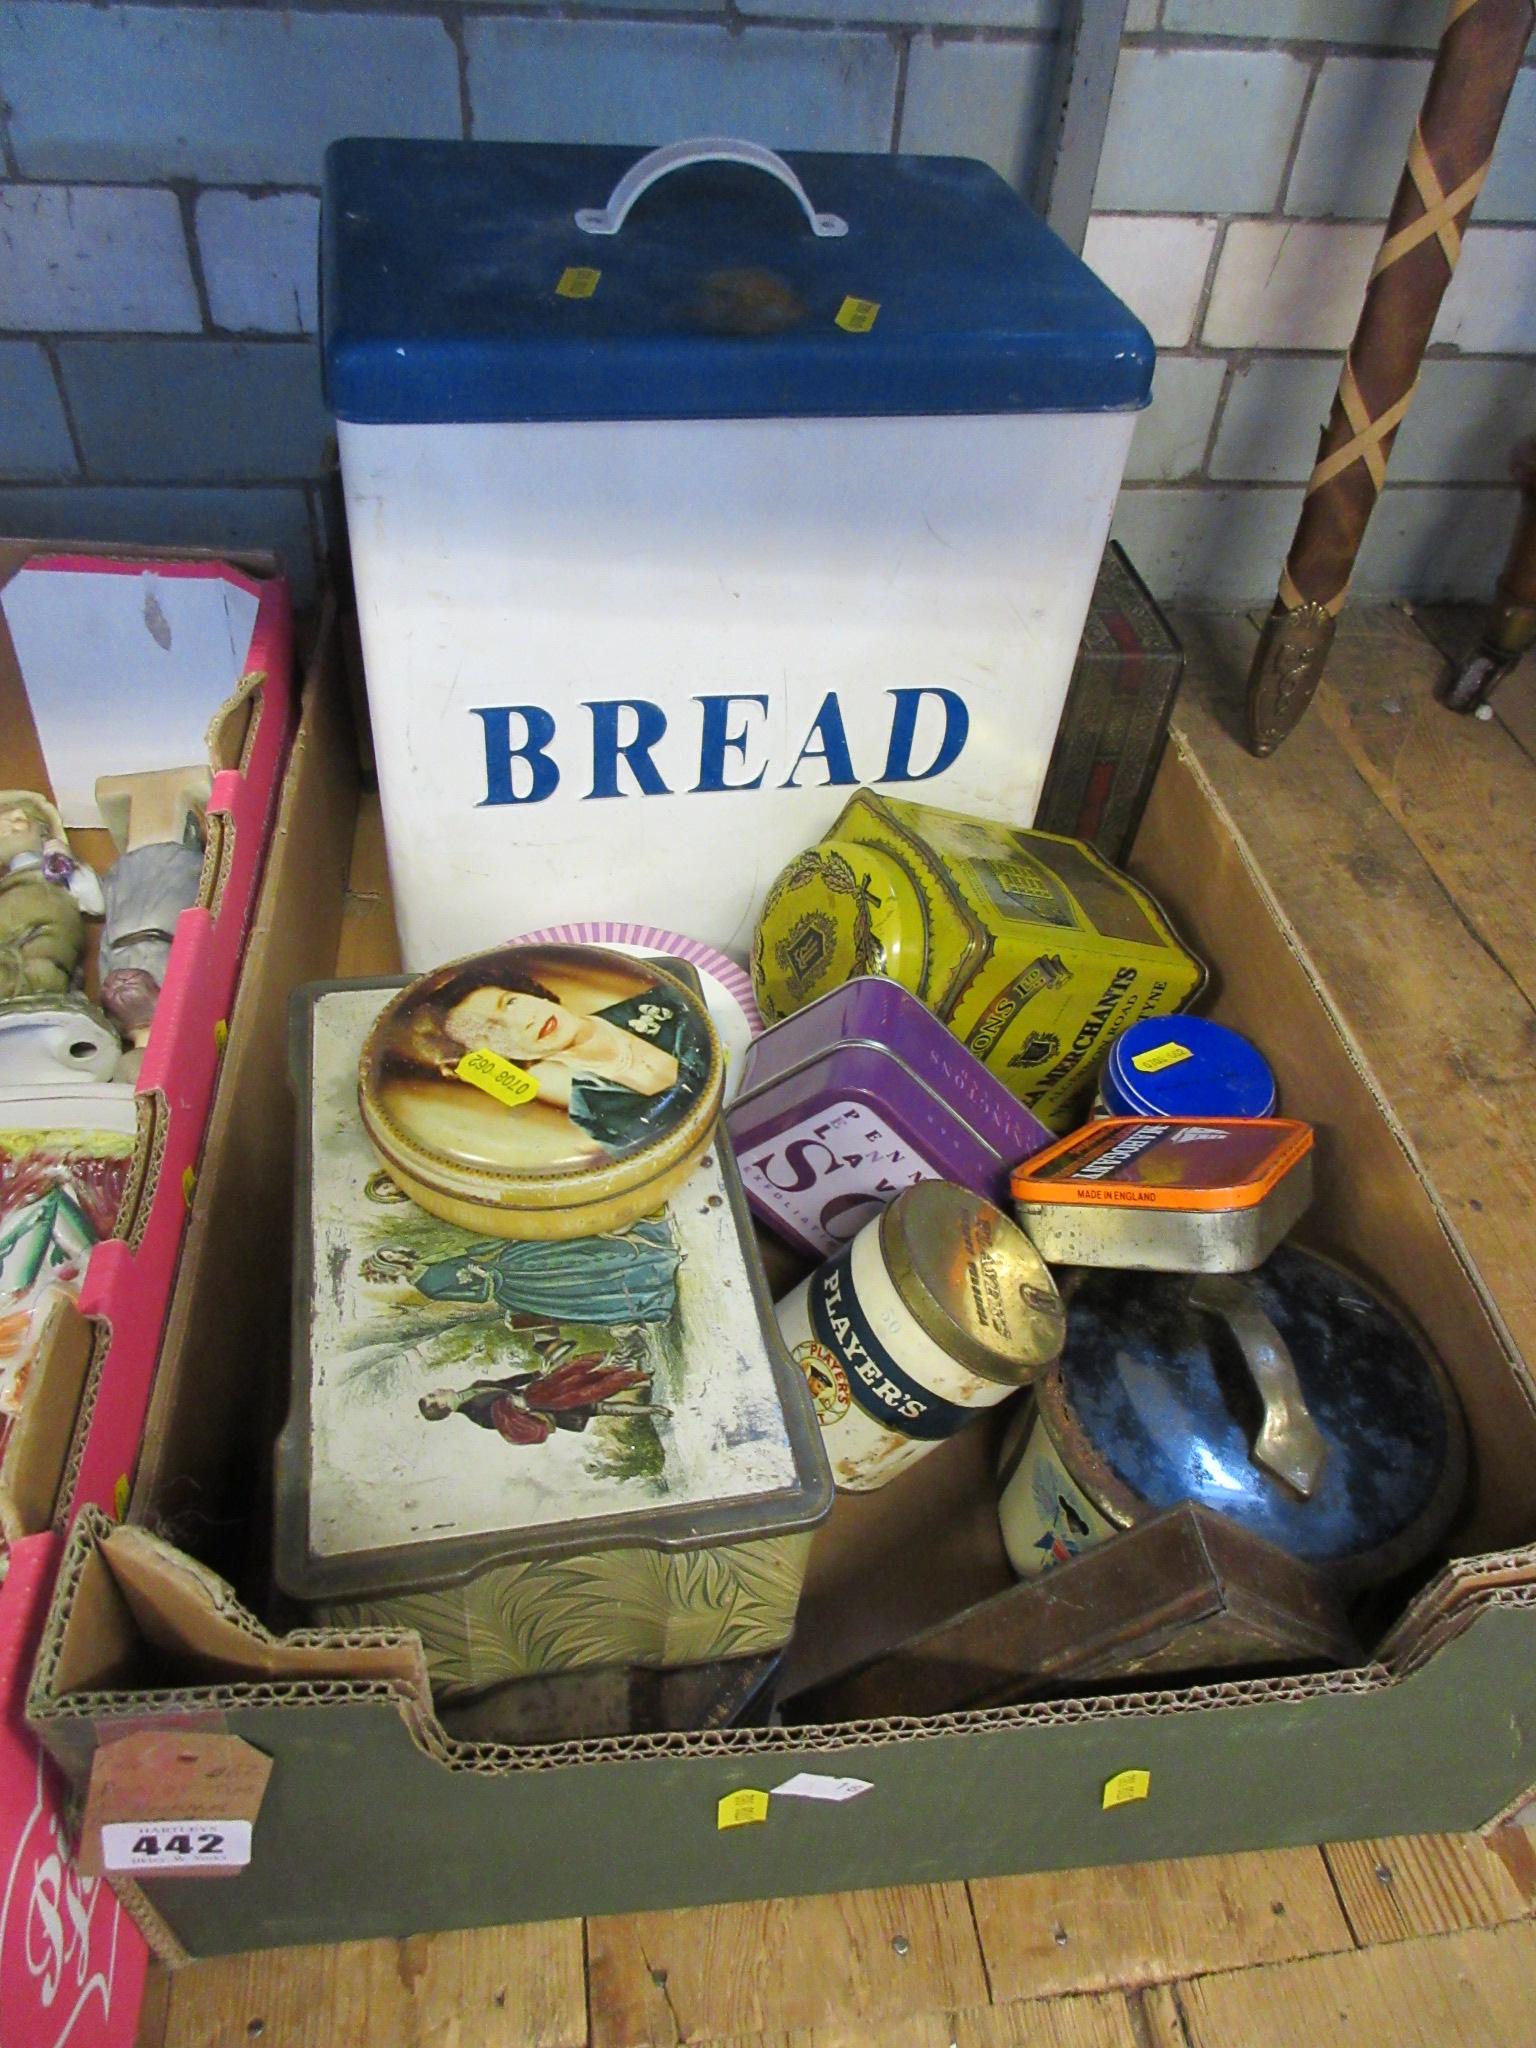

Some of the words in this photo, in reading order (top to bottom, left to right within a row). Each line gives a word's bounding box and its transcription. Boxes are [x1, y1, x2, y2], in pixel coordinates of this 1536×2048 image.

[469, 687, 969, 806] BREAD
[1107, 994, 1139, 1036] ROAD
[1137, 981, 1167, 1022] TYNE
[970, 996, 1015, 1056] ONS
[1036, 966, 1138, 1088] MERCHANTS
[468, 1054, 495, 1074] 062
[495, 1071, 530, 1091] 0708
[1077, 1190, 1101, 1200] MADE
[1104, 1191, 1112, 1200] IN
[1114, 1192, 1156, 1202] ENGLAND
[823, 1269, 928, 1418] PLAYER'S
[132, 1834, 225, 1855] 442
